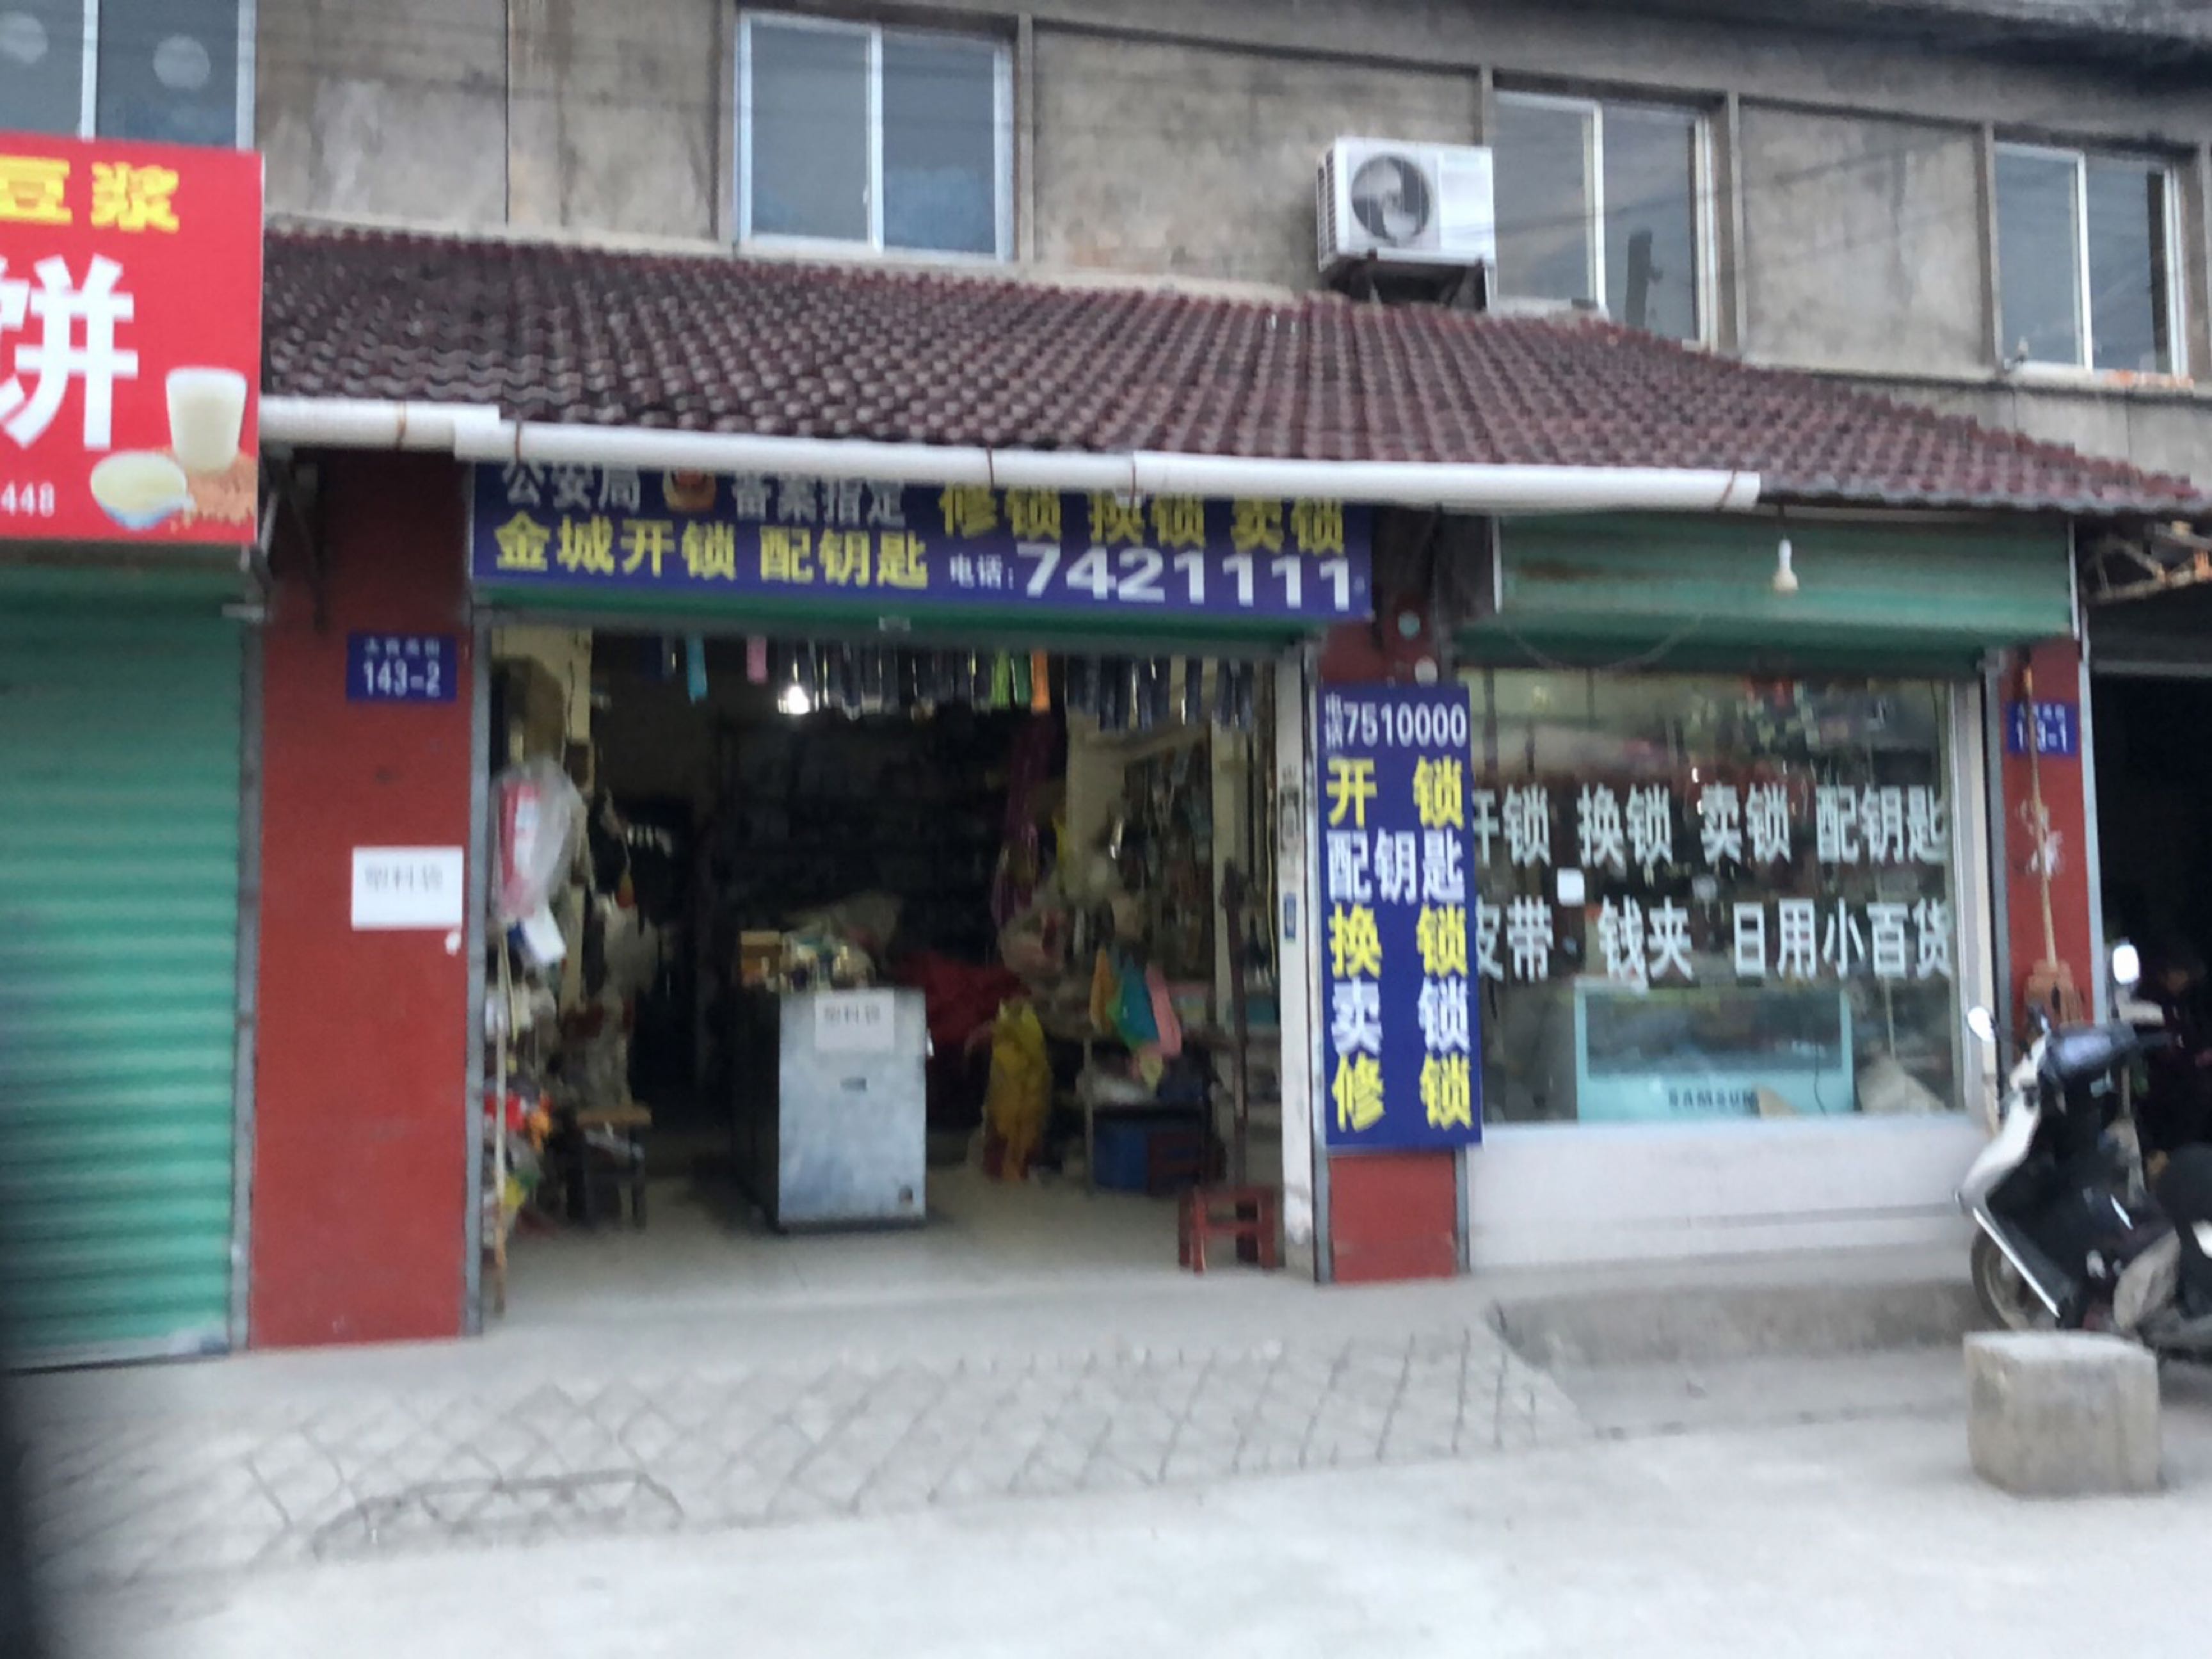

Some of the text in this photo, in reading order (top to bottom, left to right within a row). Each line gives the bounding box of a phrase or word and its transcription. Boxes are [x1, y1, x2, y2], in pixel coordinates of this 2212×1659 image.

[494, 510, 928, 589] 金城开锁 配钥匙
[1016, 542, 1350, 612] 7421111
[1343, 701, 1468, 748] 7510000
[1576, 783, 1674, 868] 换锁
[1700, 782, 1792, 864] 卖锁
[1815, 784, 1950, 864] 配钥匙
[1326, 828, 1466, 905] 配钥匙
[1599, 895, 1694, 991] 钱夹
[1733, 896, 1953, 982] 日用小百货
